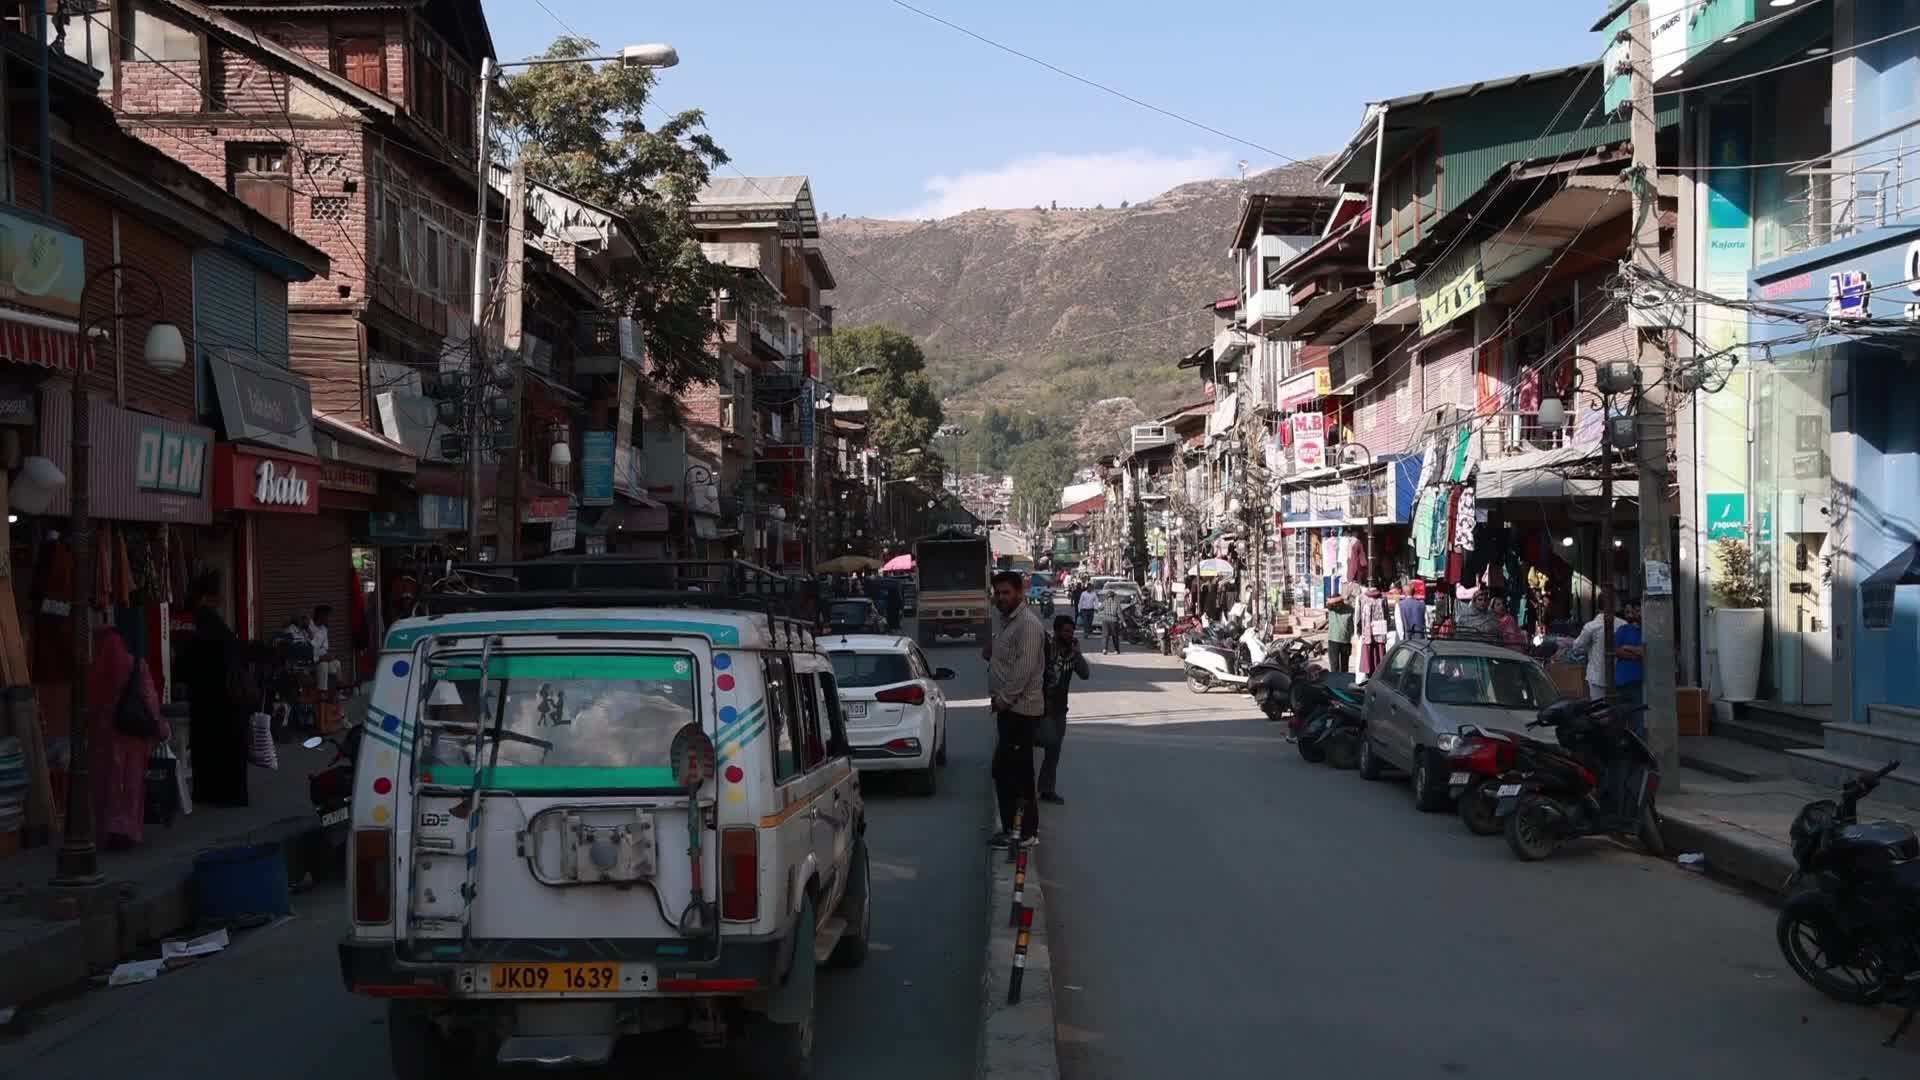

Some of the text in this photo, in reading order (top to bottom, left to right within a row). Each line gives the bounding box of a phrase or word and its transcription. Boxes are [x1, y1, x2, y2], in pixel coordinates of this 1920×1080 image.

[255, 460, 310, 506] Bata
[495, 967, 614, 989] JK09 1639
